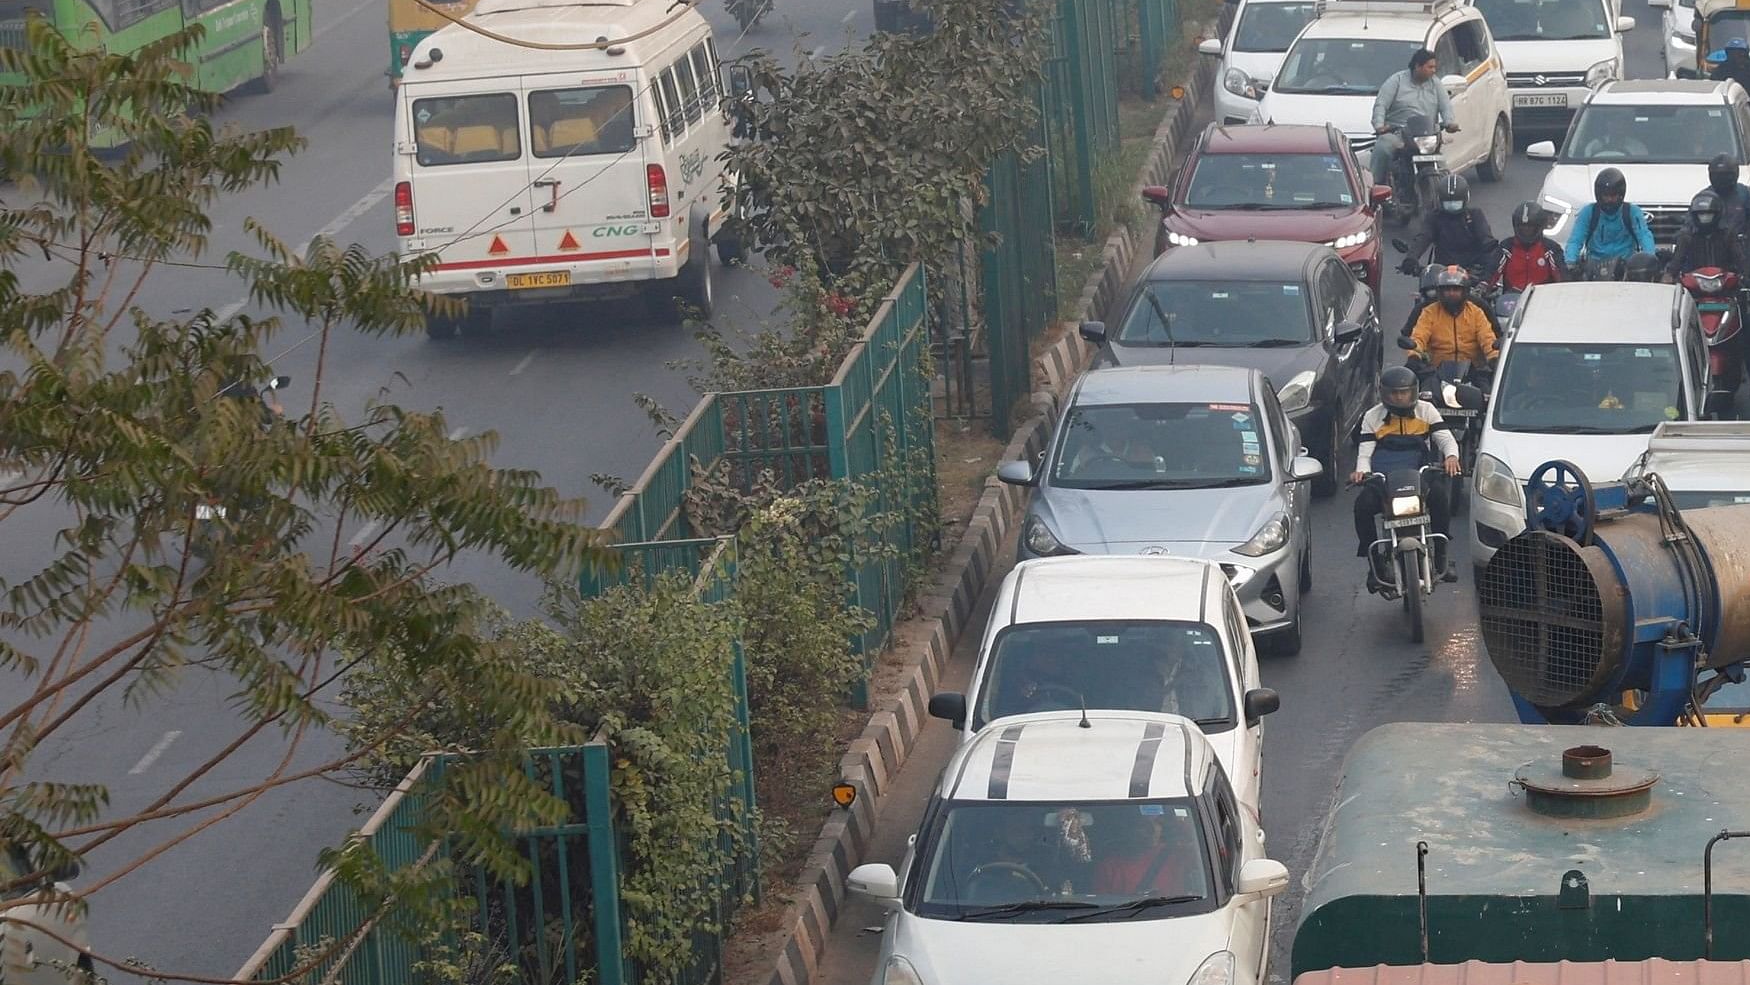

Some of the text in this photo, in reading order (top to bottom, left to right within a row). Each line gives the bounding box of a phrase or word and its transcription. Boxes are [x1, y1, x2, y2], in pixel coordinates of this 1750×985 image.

[592, 225, 639, 238] CNG
[513, 275, 525, 286] DL
[547, 273, 569, 285] 5071
